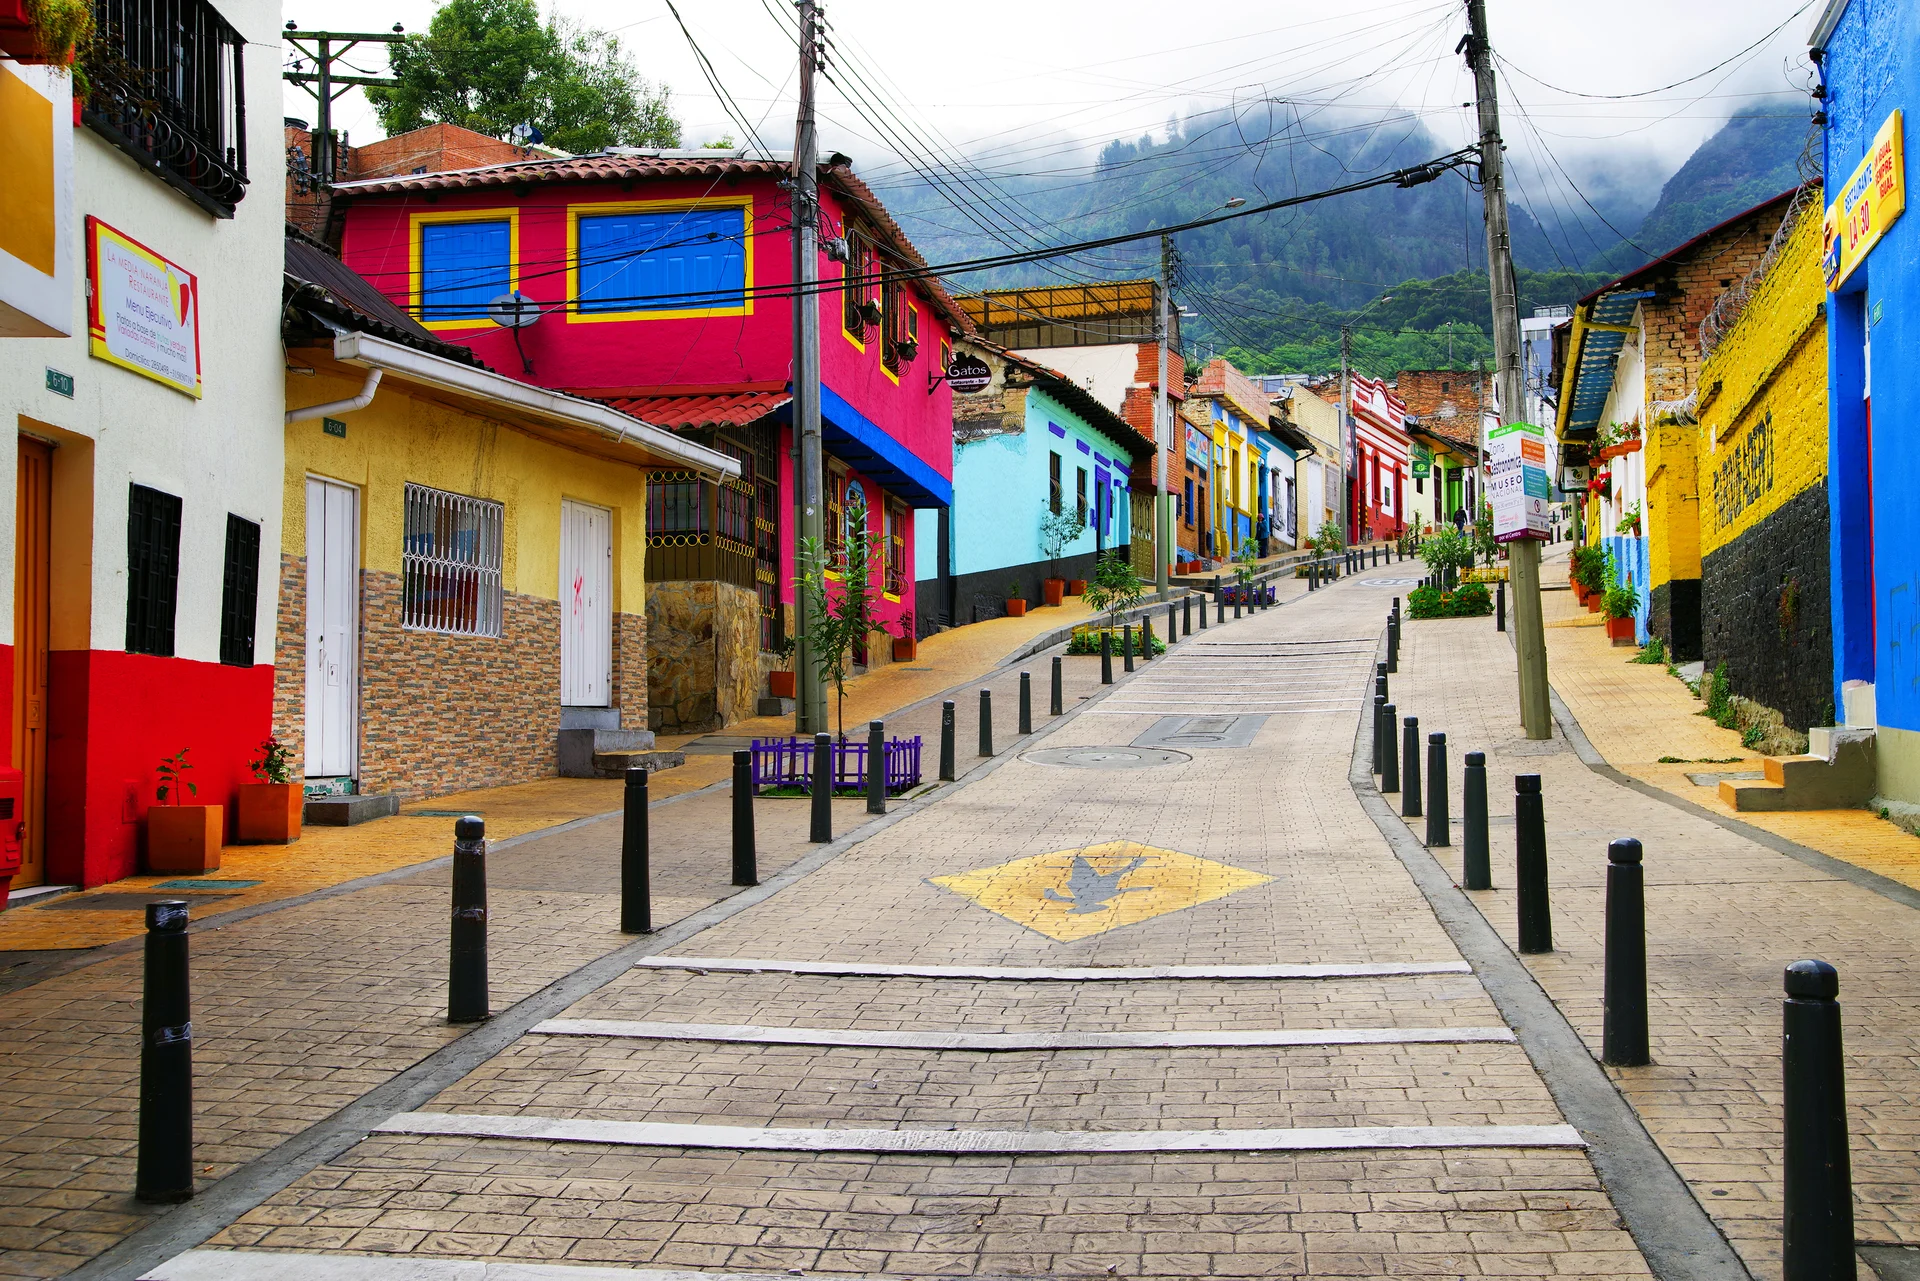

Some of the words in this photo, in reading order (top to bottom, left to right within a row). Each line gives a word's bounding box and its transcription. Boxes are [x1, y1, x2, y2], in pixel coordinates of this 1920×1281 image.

[1844, 162, 1873, 216] RESTAURANTE
[1879, 174, 1893, 199] IGUAL
[1849, 218, 1858, 251] LA
[1860, 200, 1870, 236] 30
[107, 248, 116, 264] LA
[118, 257, 138, 277] MEDIA
[141, 269, 168, 292] NARANJA
[128, 274, 169, 307] RESTAURANTE
[125, 296, 144, 316] Menu
[145, 305, 172, 330] Ejecutivo
[117, 311, 131, 328] Platos
[136, 320, 148, 336] base
[150, 327, 156, 340] de
[117, 322, 139, 341] Variadas
[948, 364, 987, 377] Gatos
[53, 373, 69, 391] 6-10
[328, 421, 342, 434] 6-04
[1488, 443, 1505, 456] Zona
[1490, 475, 1522, 492] MUSEO
[1491, 487, 1522, 499] NACIONAL
